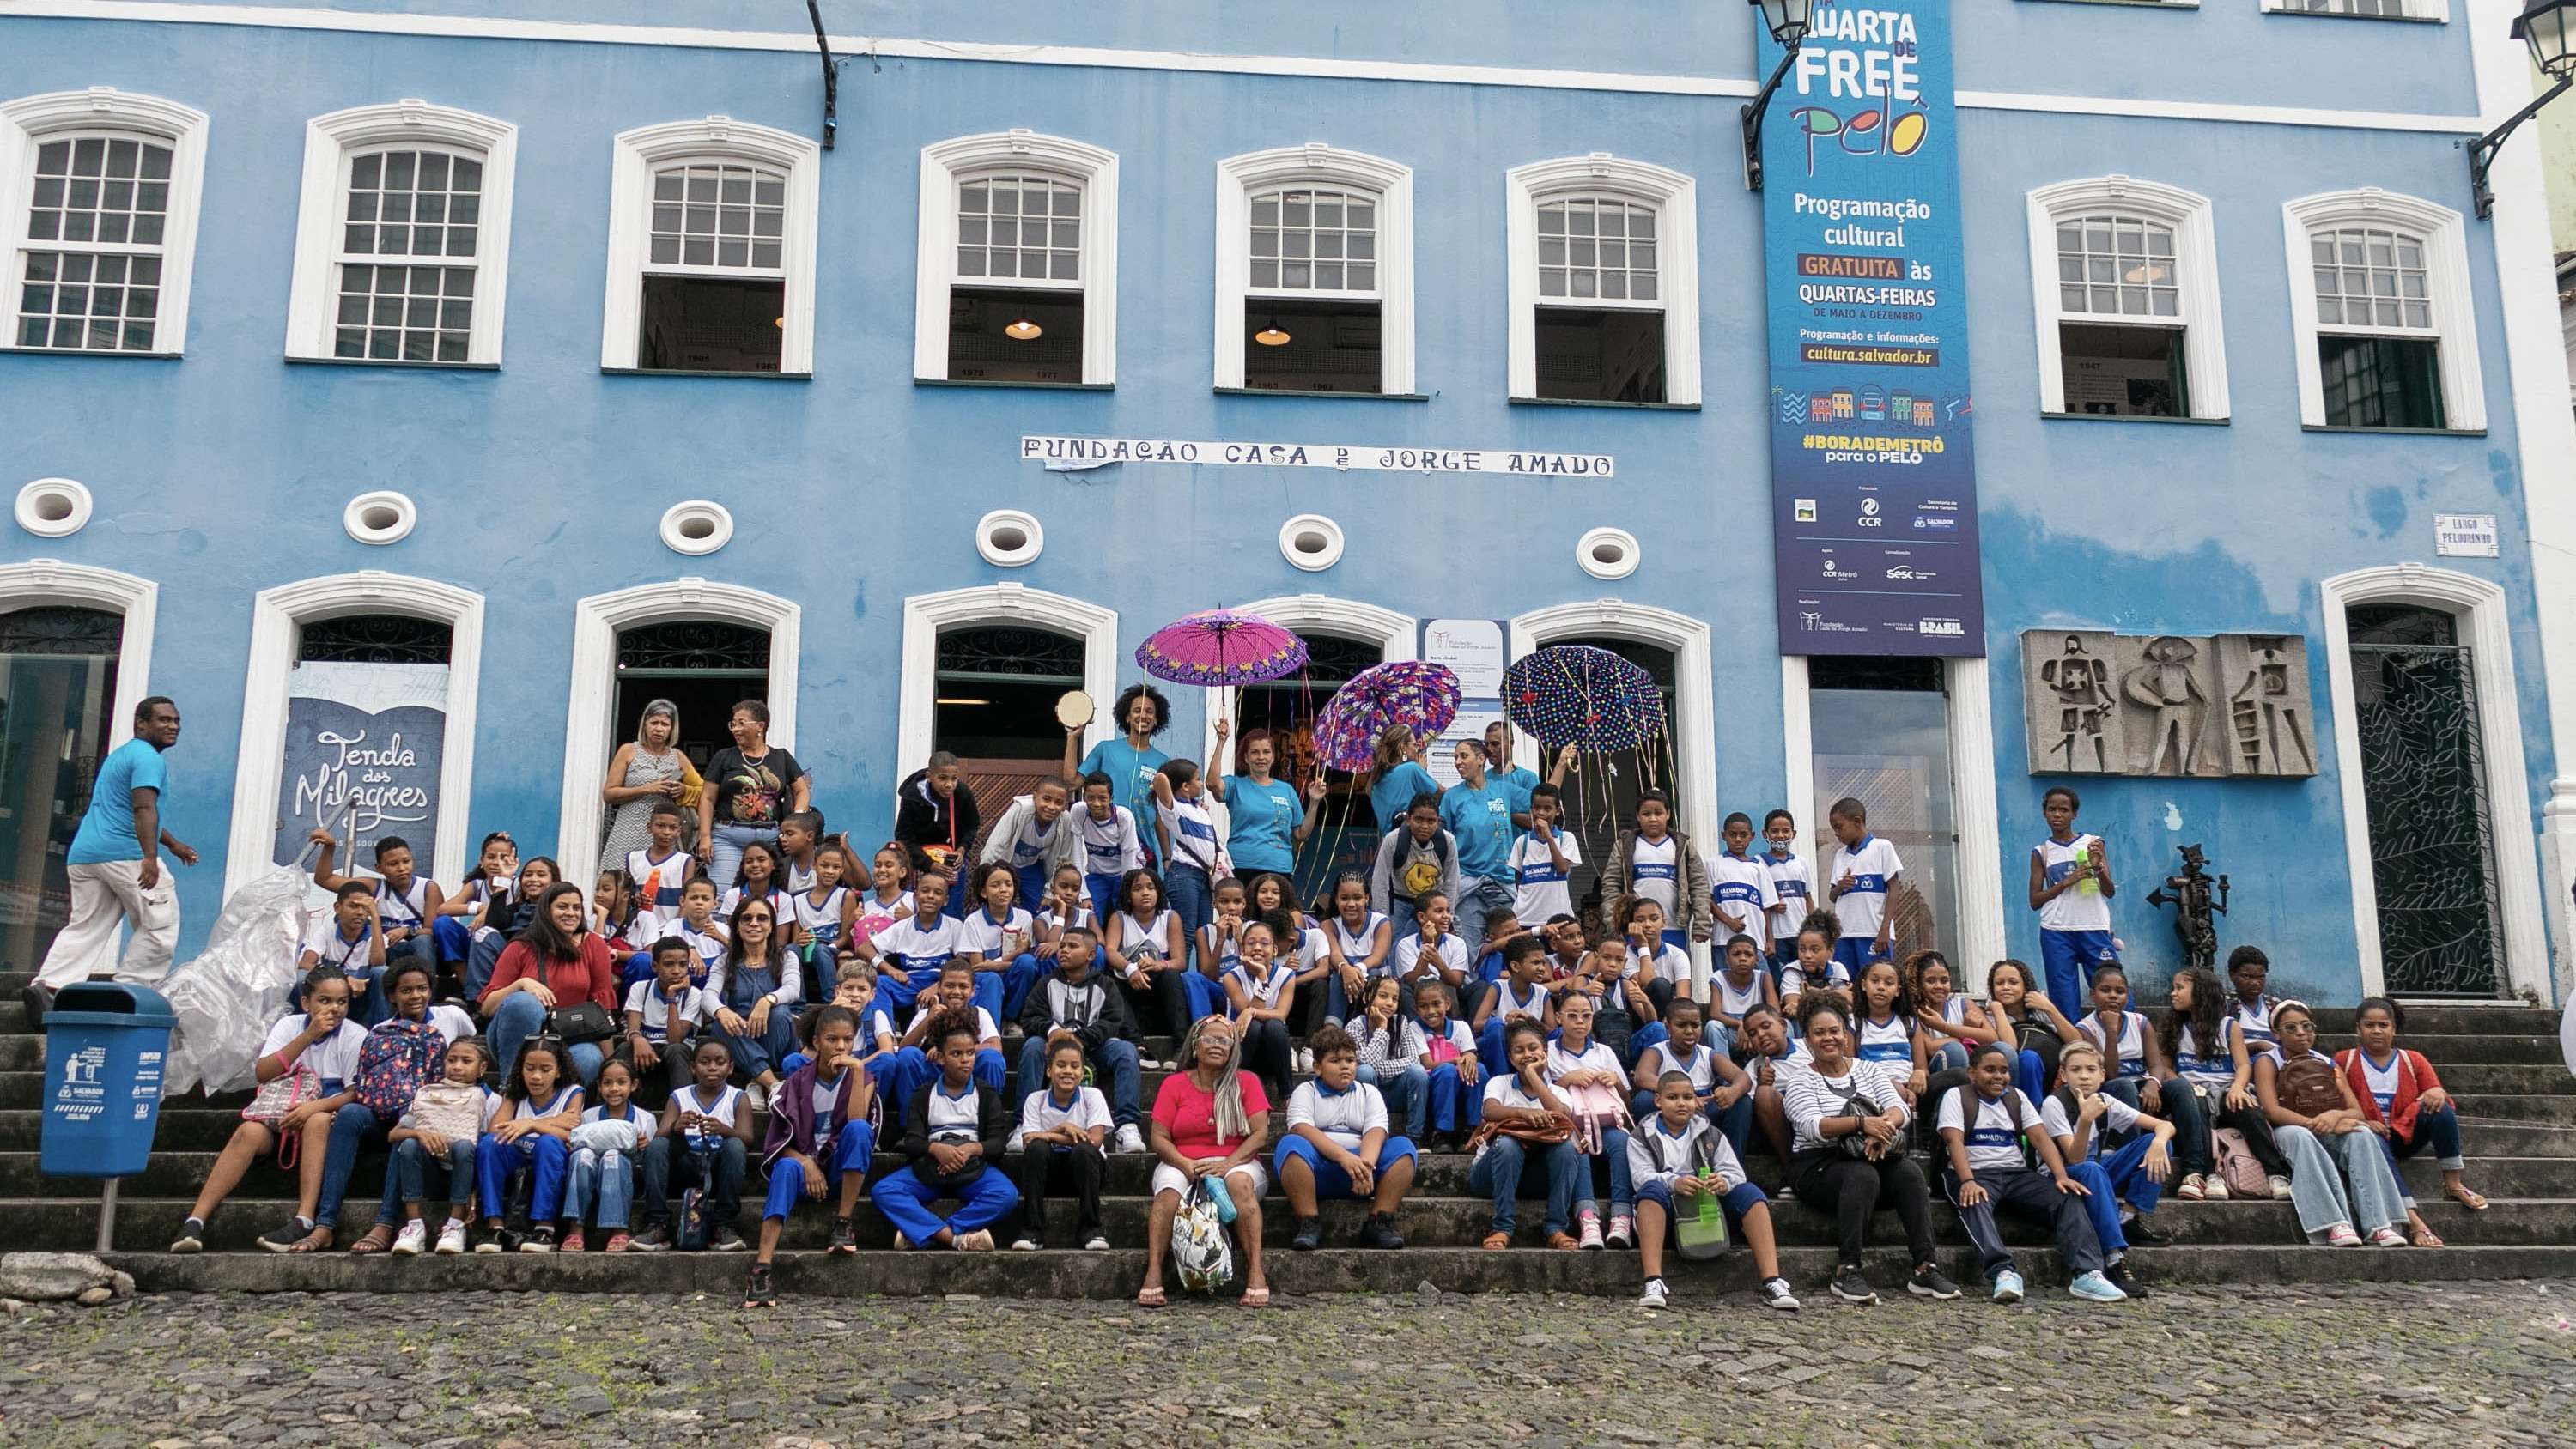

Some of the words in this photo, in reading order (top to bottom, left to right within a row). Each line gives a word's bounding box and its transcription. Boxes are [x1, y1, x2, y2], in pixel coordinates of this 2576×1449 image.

[1893, 41, 1916, 58] DE
[1795, 48, 1919, 100] FREE
[1795, 193, 1930, 223] Programação
[1824, 224, 1905, 247] cultural
[1805, 257, 1899, 277] GRATUITA
[1910, 260, 1932, 282] às
[1799, 284, 1936, 306] QUARTAS-FEIRAS
[1814, 307, 1826, 317] DE
[1829, 309, 1856, 318] MAIO
[1860, 310, 1867, 319] A
[1869, 310, 1923, 321] DEZEMBRO
[1800, 329, 1863, 343] Programação
[1877, 331, 1940, 346] informações:
[1807, 346, 1932, 365] cultura.salvador.br
[1802, 434, 1945, 454] #BORADEMETRÔ
[1024, 438, 1199, 462] FUNDAÇÃO
[1225, 444, 1308, 464] CASA
[1379, 450, 1482, 470] JORGE
[1508, 454, 1611, 475] AMADO
[1826, 452, 1864, 464] para
[1866, 452, 1877, 463] o
[1880, 449, 1923, 464] PELÔ
[1857, 517, 1882, 527] CCR
[2453, 519, 2477, 530] LARGO
[2442, 532, 2492, 544] PELOURINHO
[1919, 621, 1965, 634] BRASIL
[317, 729, 416, 773] Tenda
[362, 769, 392, 783] dos
[295, 763, 428, 832] Milagres
[1525, 867, 1552, 876] SALVADOR
